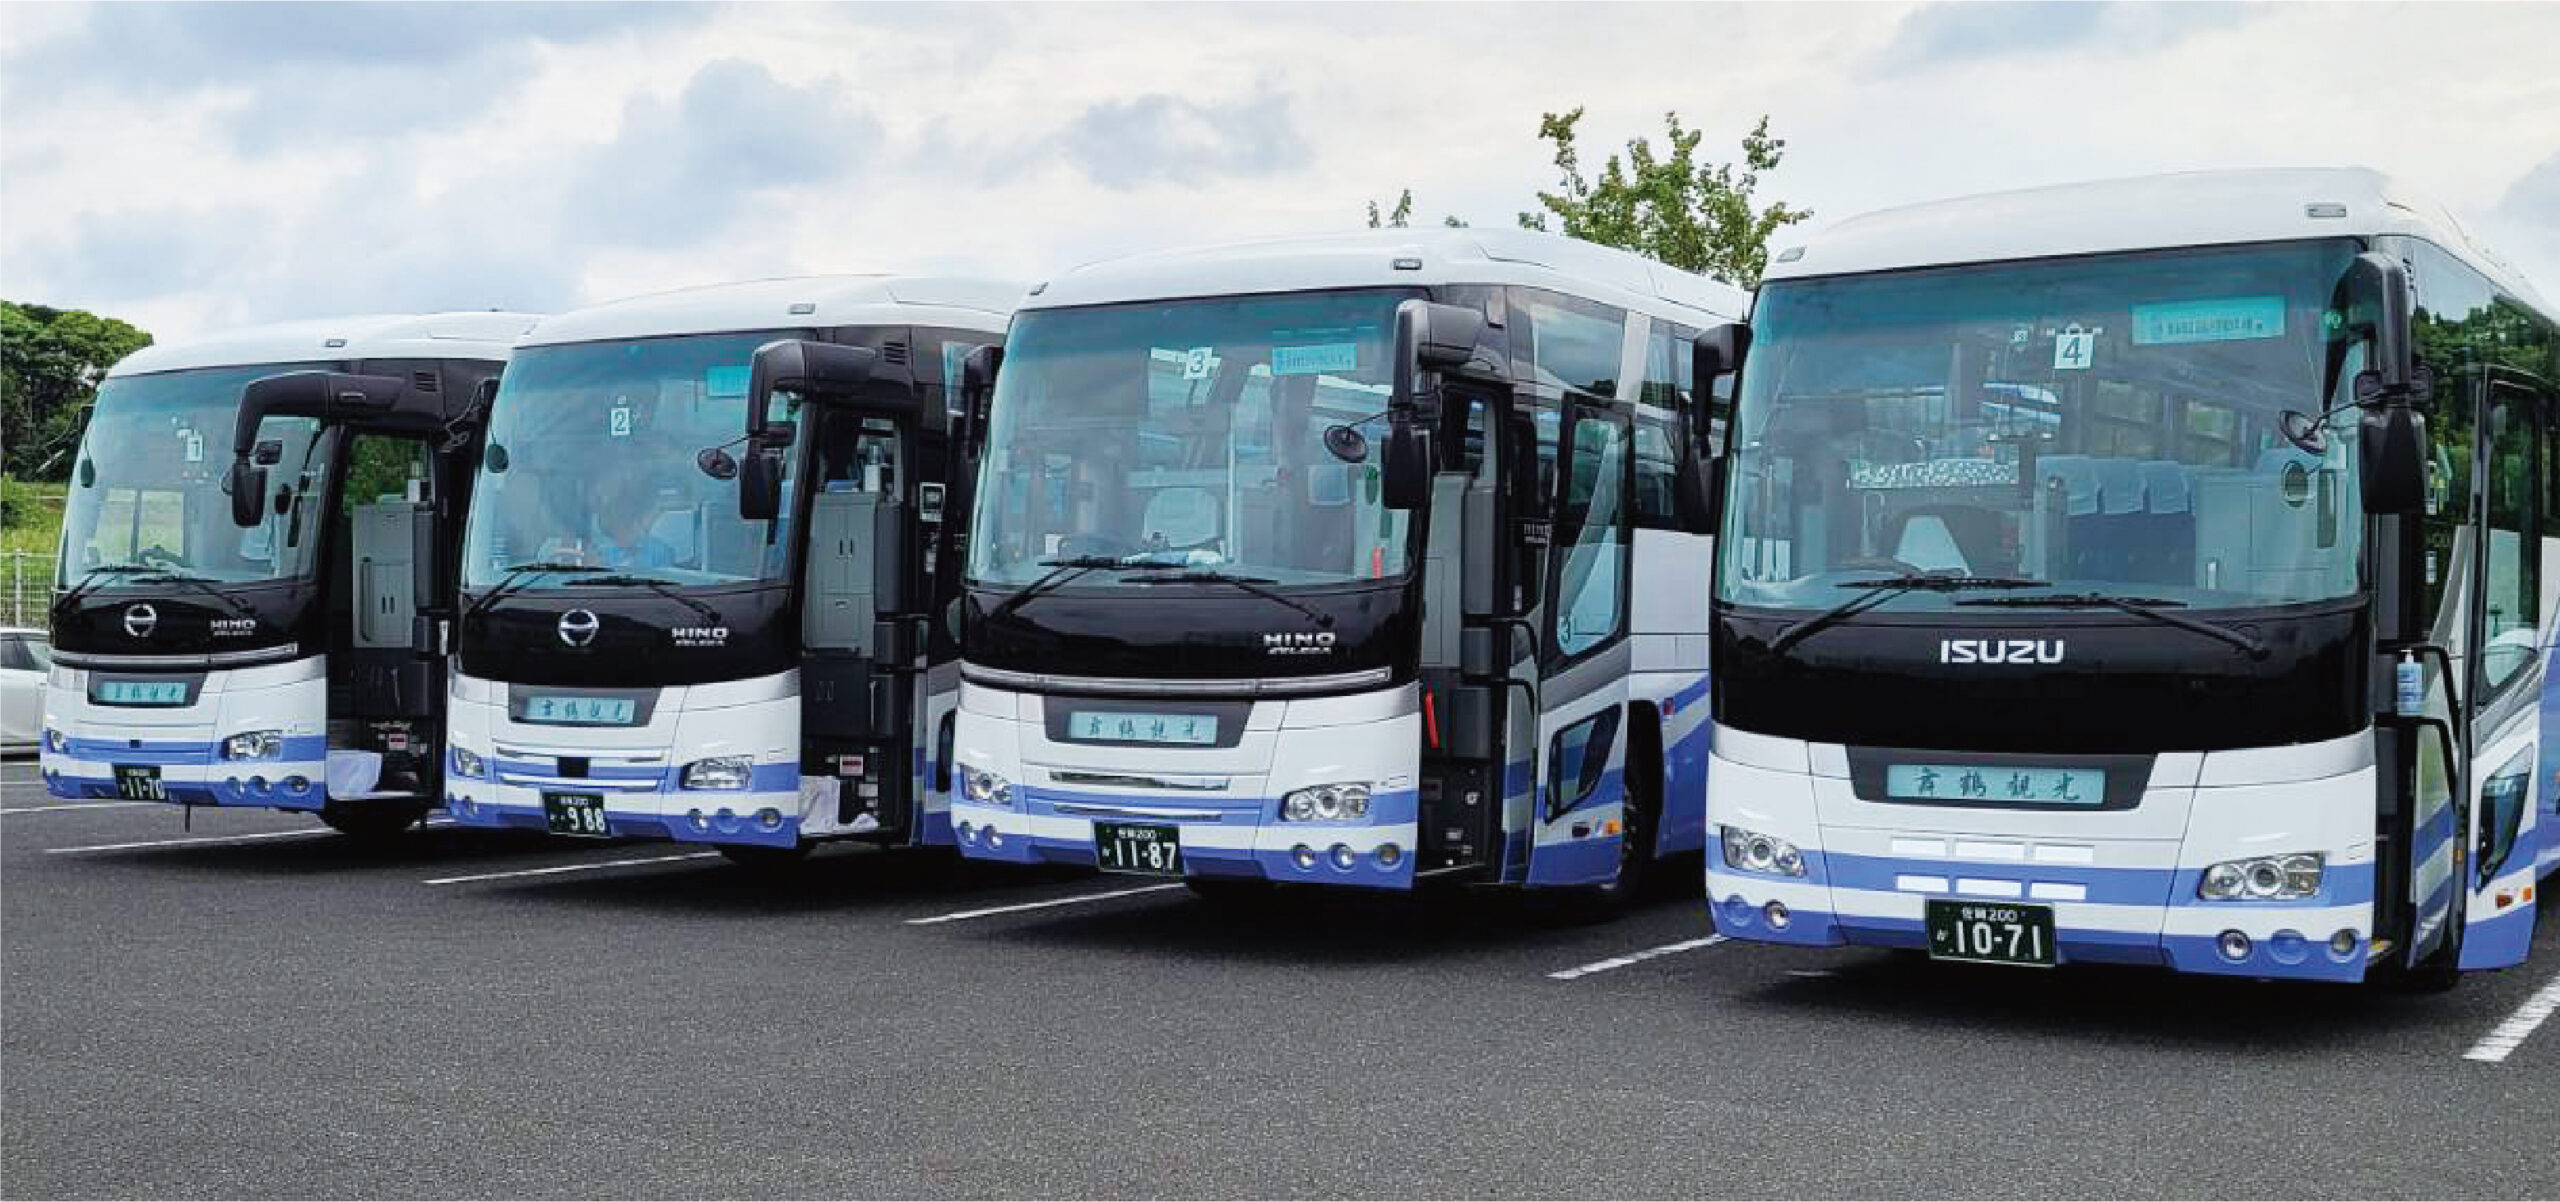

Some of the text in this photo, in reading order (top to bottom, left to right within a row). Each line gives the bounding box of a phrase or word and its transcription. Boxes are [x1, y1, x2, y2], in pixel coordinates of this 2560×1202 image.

[1190, 351, 1206, 373] 3
[2063, 337, 2083, 365] 4
[615, 411, 626, 431] 2
[671, 628, 729, 638] HINO
[1263, 632, 1336, 647] HINO
[1940, 640, 2064, 664] ISUZU
[1115, 838, 1176, 871] 11-87
[1956, 920, 2041, 959] 10-71
